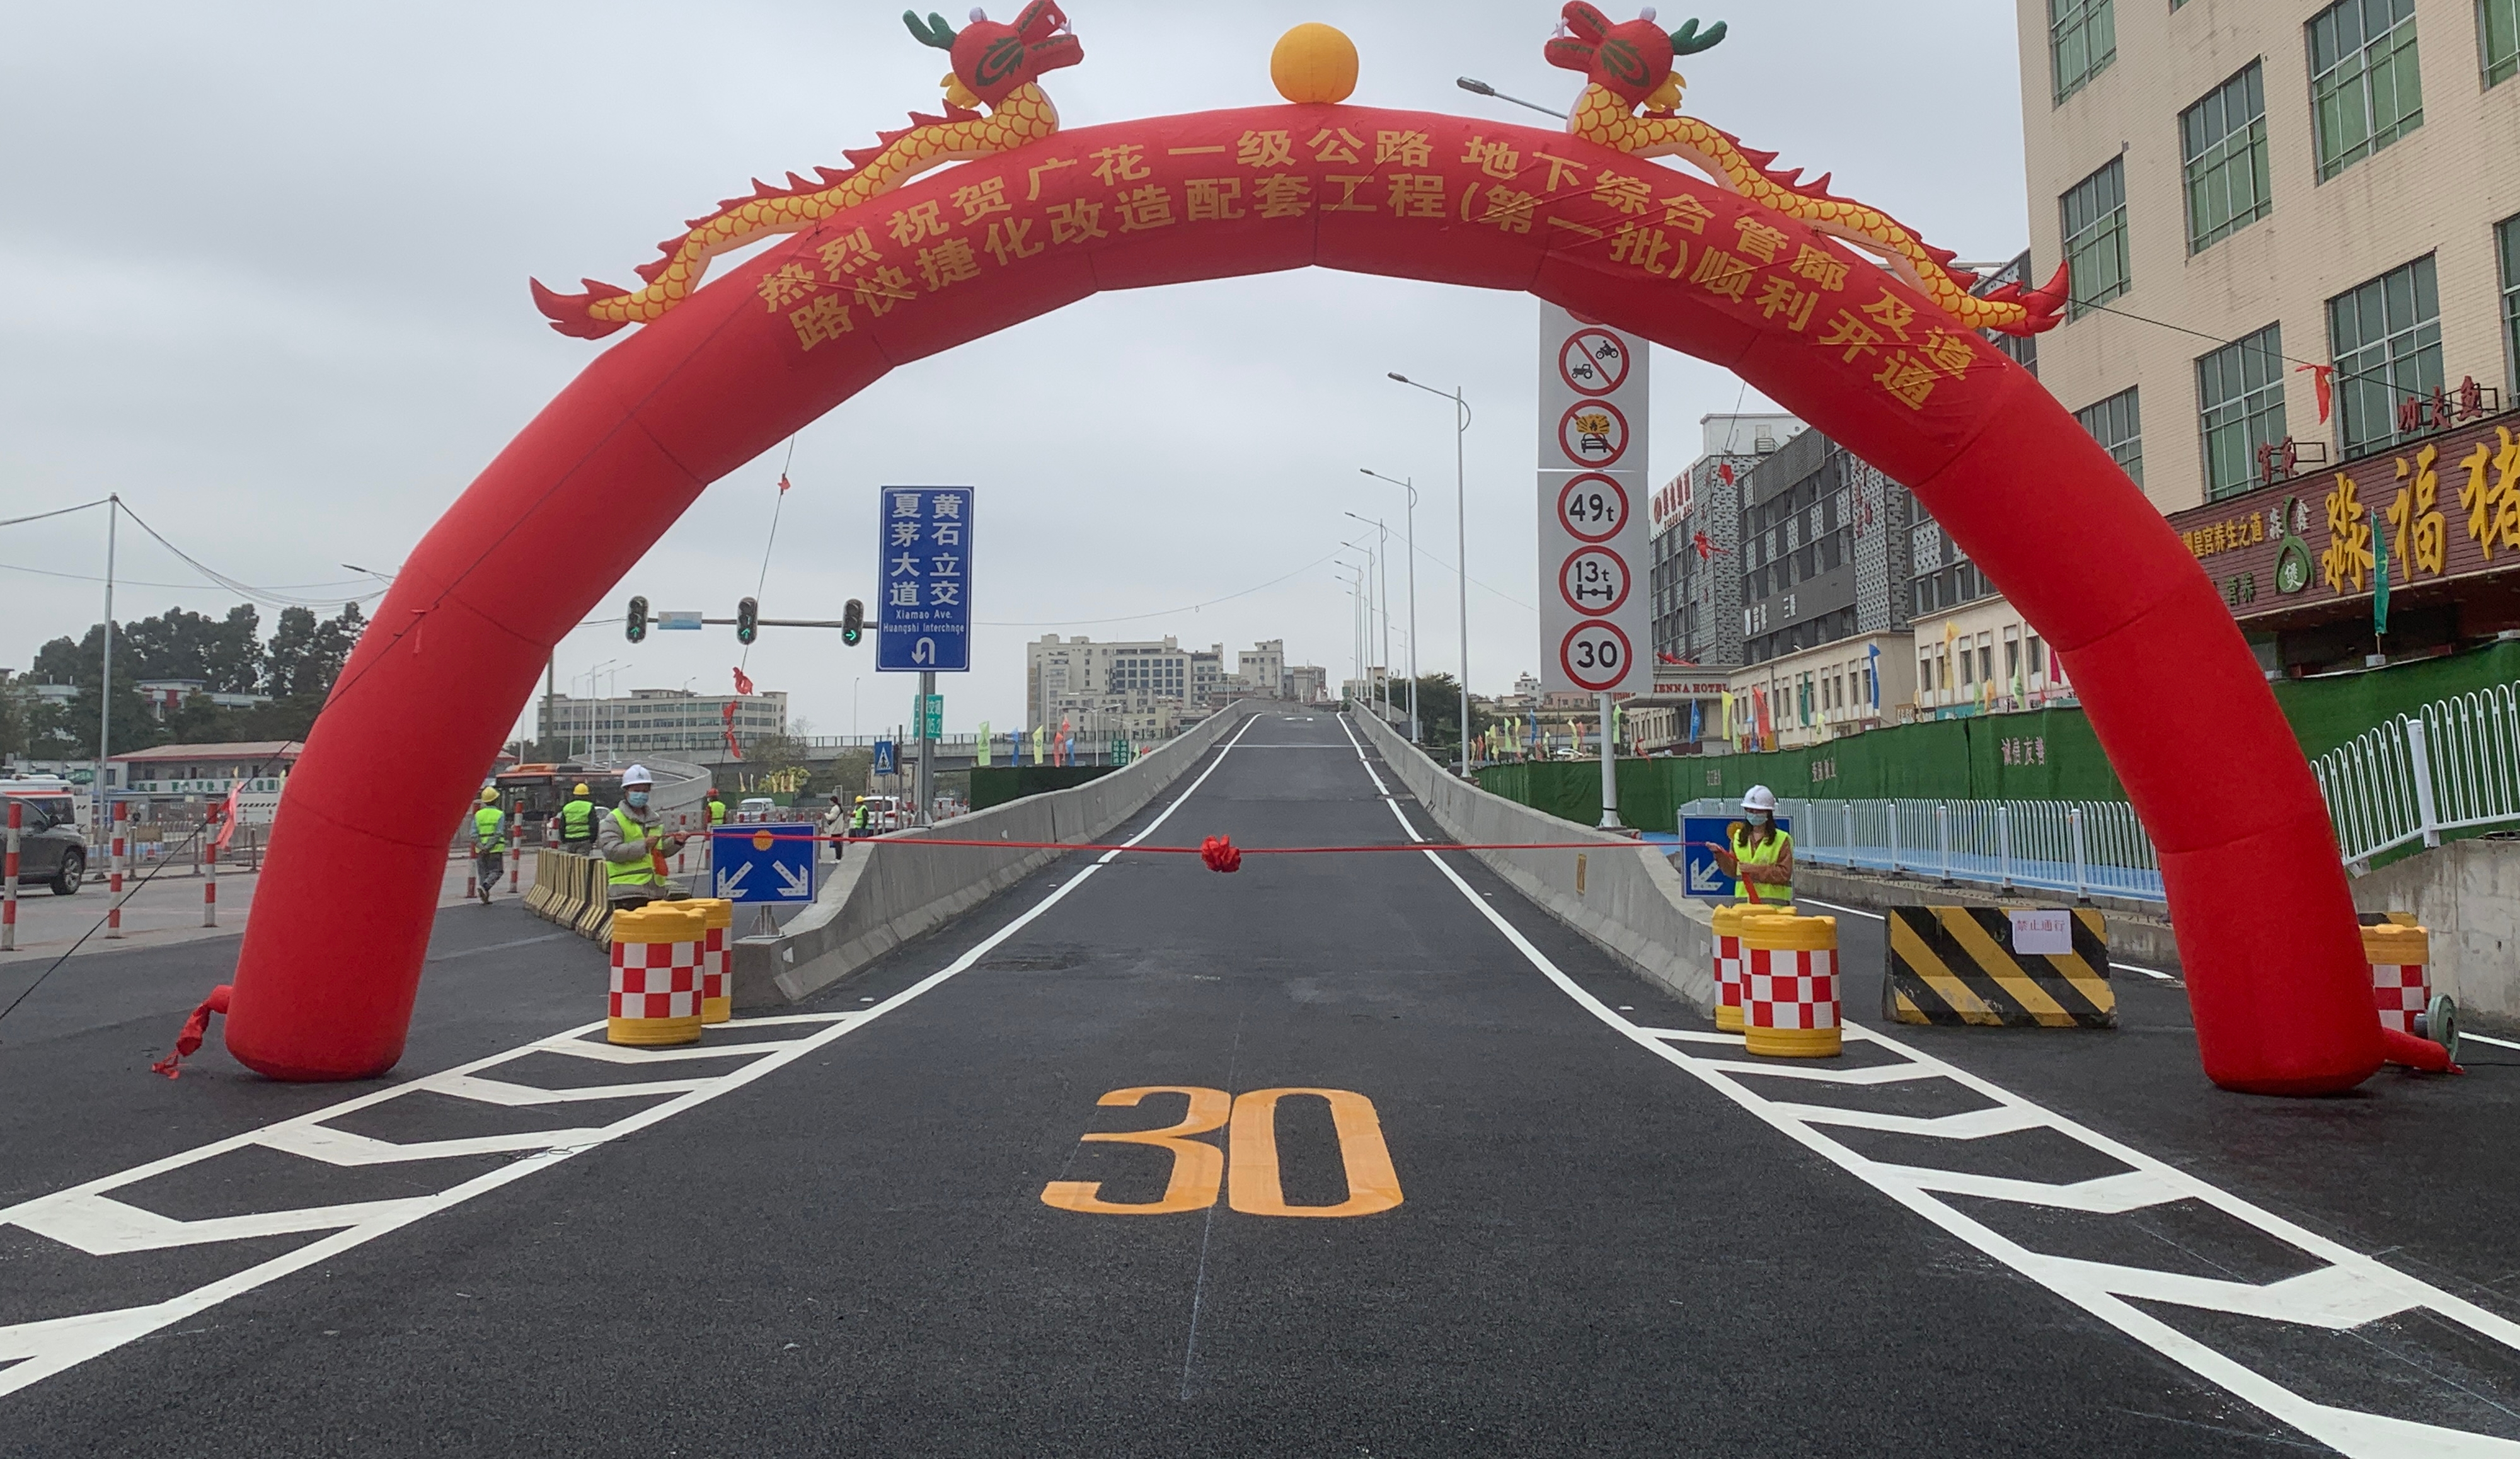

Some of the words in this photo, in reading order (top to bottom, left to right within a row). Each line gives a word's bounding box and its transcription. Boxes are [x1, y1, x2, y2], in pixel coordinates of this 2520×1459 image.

[1569, 494, 1614, 522] 49t
[889, 493, 922, 606] 夏茅大道
[929, 494, 963, 606] 黄石立交
[1575, 561, 1609, 582] 13t
[895, 609, 929, 619] Xiamao
[933, 609, 953, 619] Ave.
[883, 622, 919, 634] Huangshi
[1577, 640, 1617, 668] 30
[1654, 683, 1690, 693] IENNA
[1693, 683, 1729, 693] HOTEL
[2017, 919, 2065, 932] 禁止通行
[1040, 1085, 1404, 1218] 30
